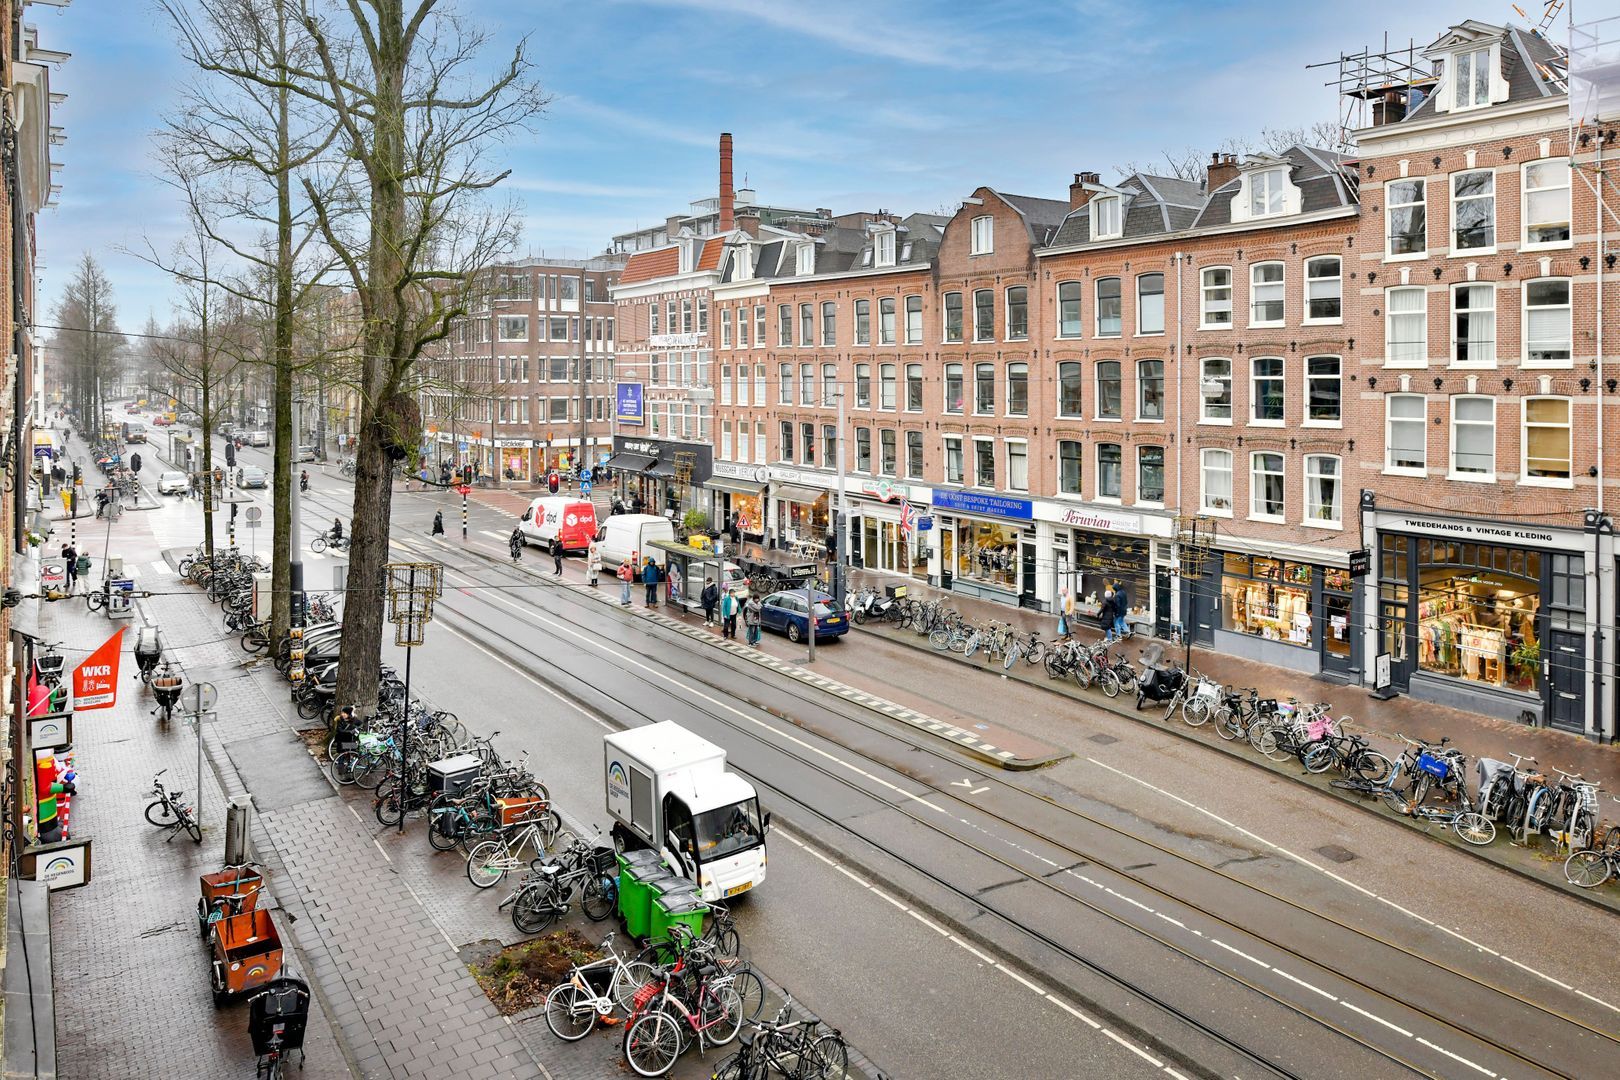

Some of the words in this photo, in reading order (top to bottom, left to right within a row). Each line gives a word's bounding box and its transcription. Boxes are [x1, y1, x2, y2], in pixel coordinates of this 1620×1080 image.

[948, 493, 963, 501] OOST
[963, 495, 989, 505] BESPOKE
[989, 498, 1023, 510] TAILORING
[546, 511, 557, 525] dpd
[580, 515, 593, 524] dpd
[1061, 507, 1111, 529] Peruvian
[1405, 519, 1464, 532] TWEEDEHANDS
[1476, 527, 1512, 537] VINTAGE
[1514, 531, 1553, 541] KLEDING
[82, 665, 111, 677] WKR
[51, 869, 75, 877] REGENBOOG
